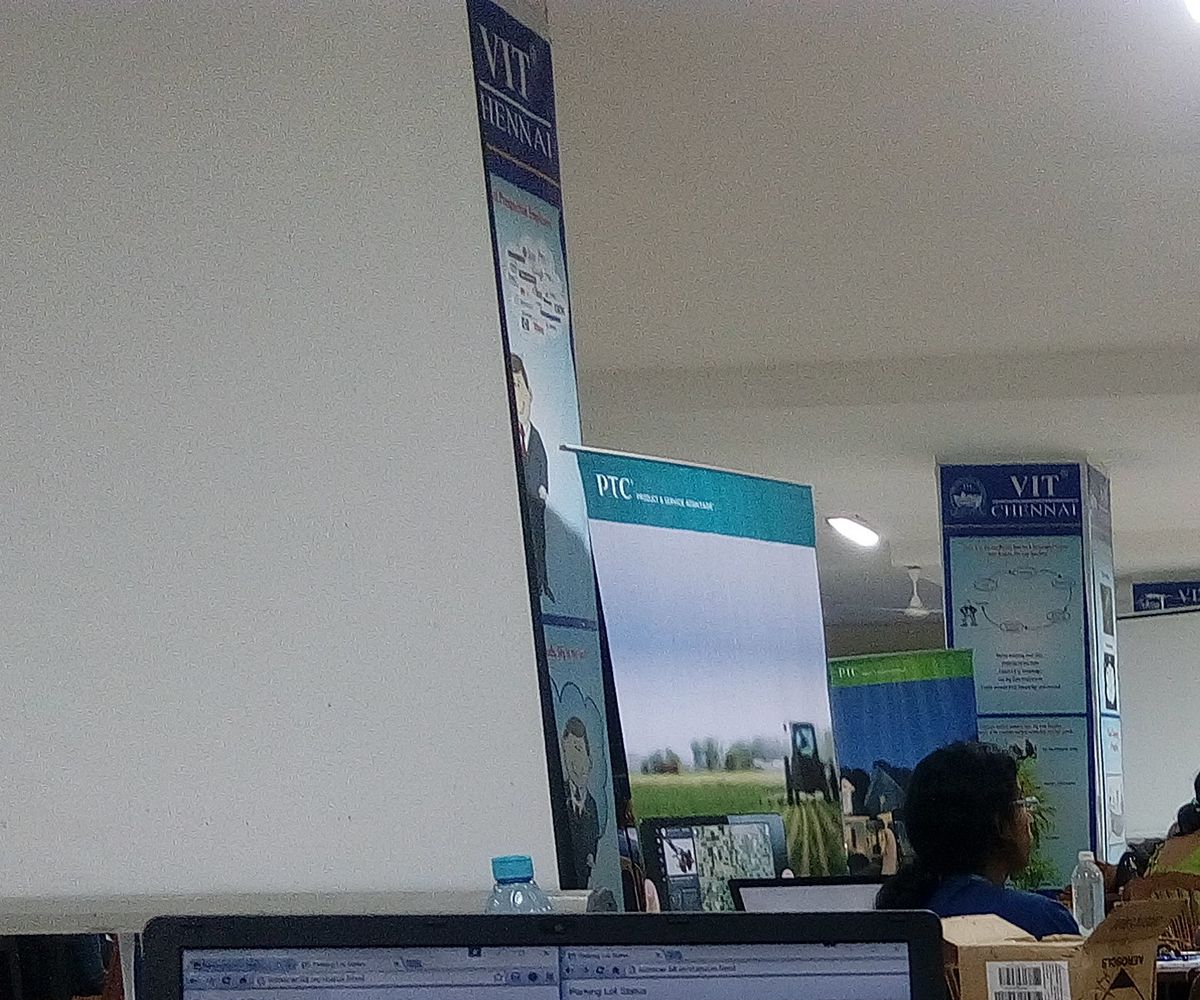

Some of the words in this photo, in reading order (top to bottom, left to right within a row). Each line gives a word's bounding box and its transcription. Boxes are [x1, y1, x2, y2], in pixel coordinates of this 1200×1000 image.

[477, 22, 531, 100] VIT
[480, 94, 553, 159] HENNAI
[595, 473, 632, 500] PTC
[1009, 474, 1060, 498] VIT
[991, 502, 1077, 518] CHENNAI
